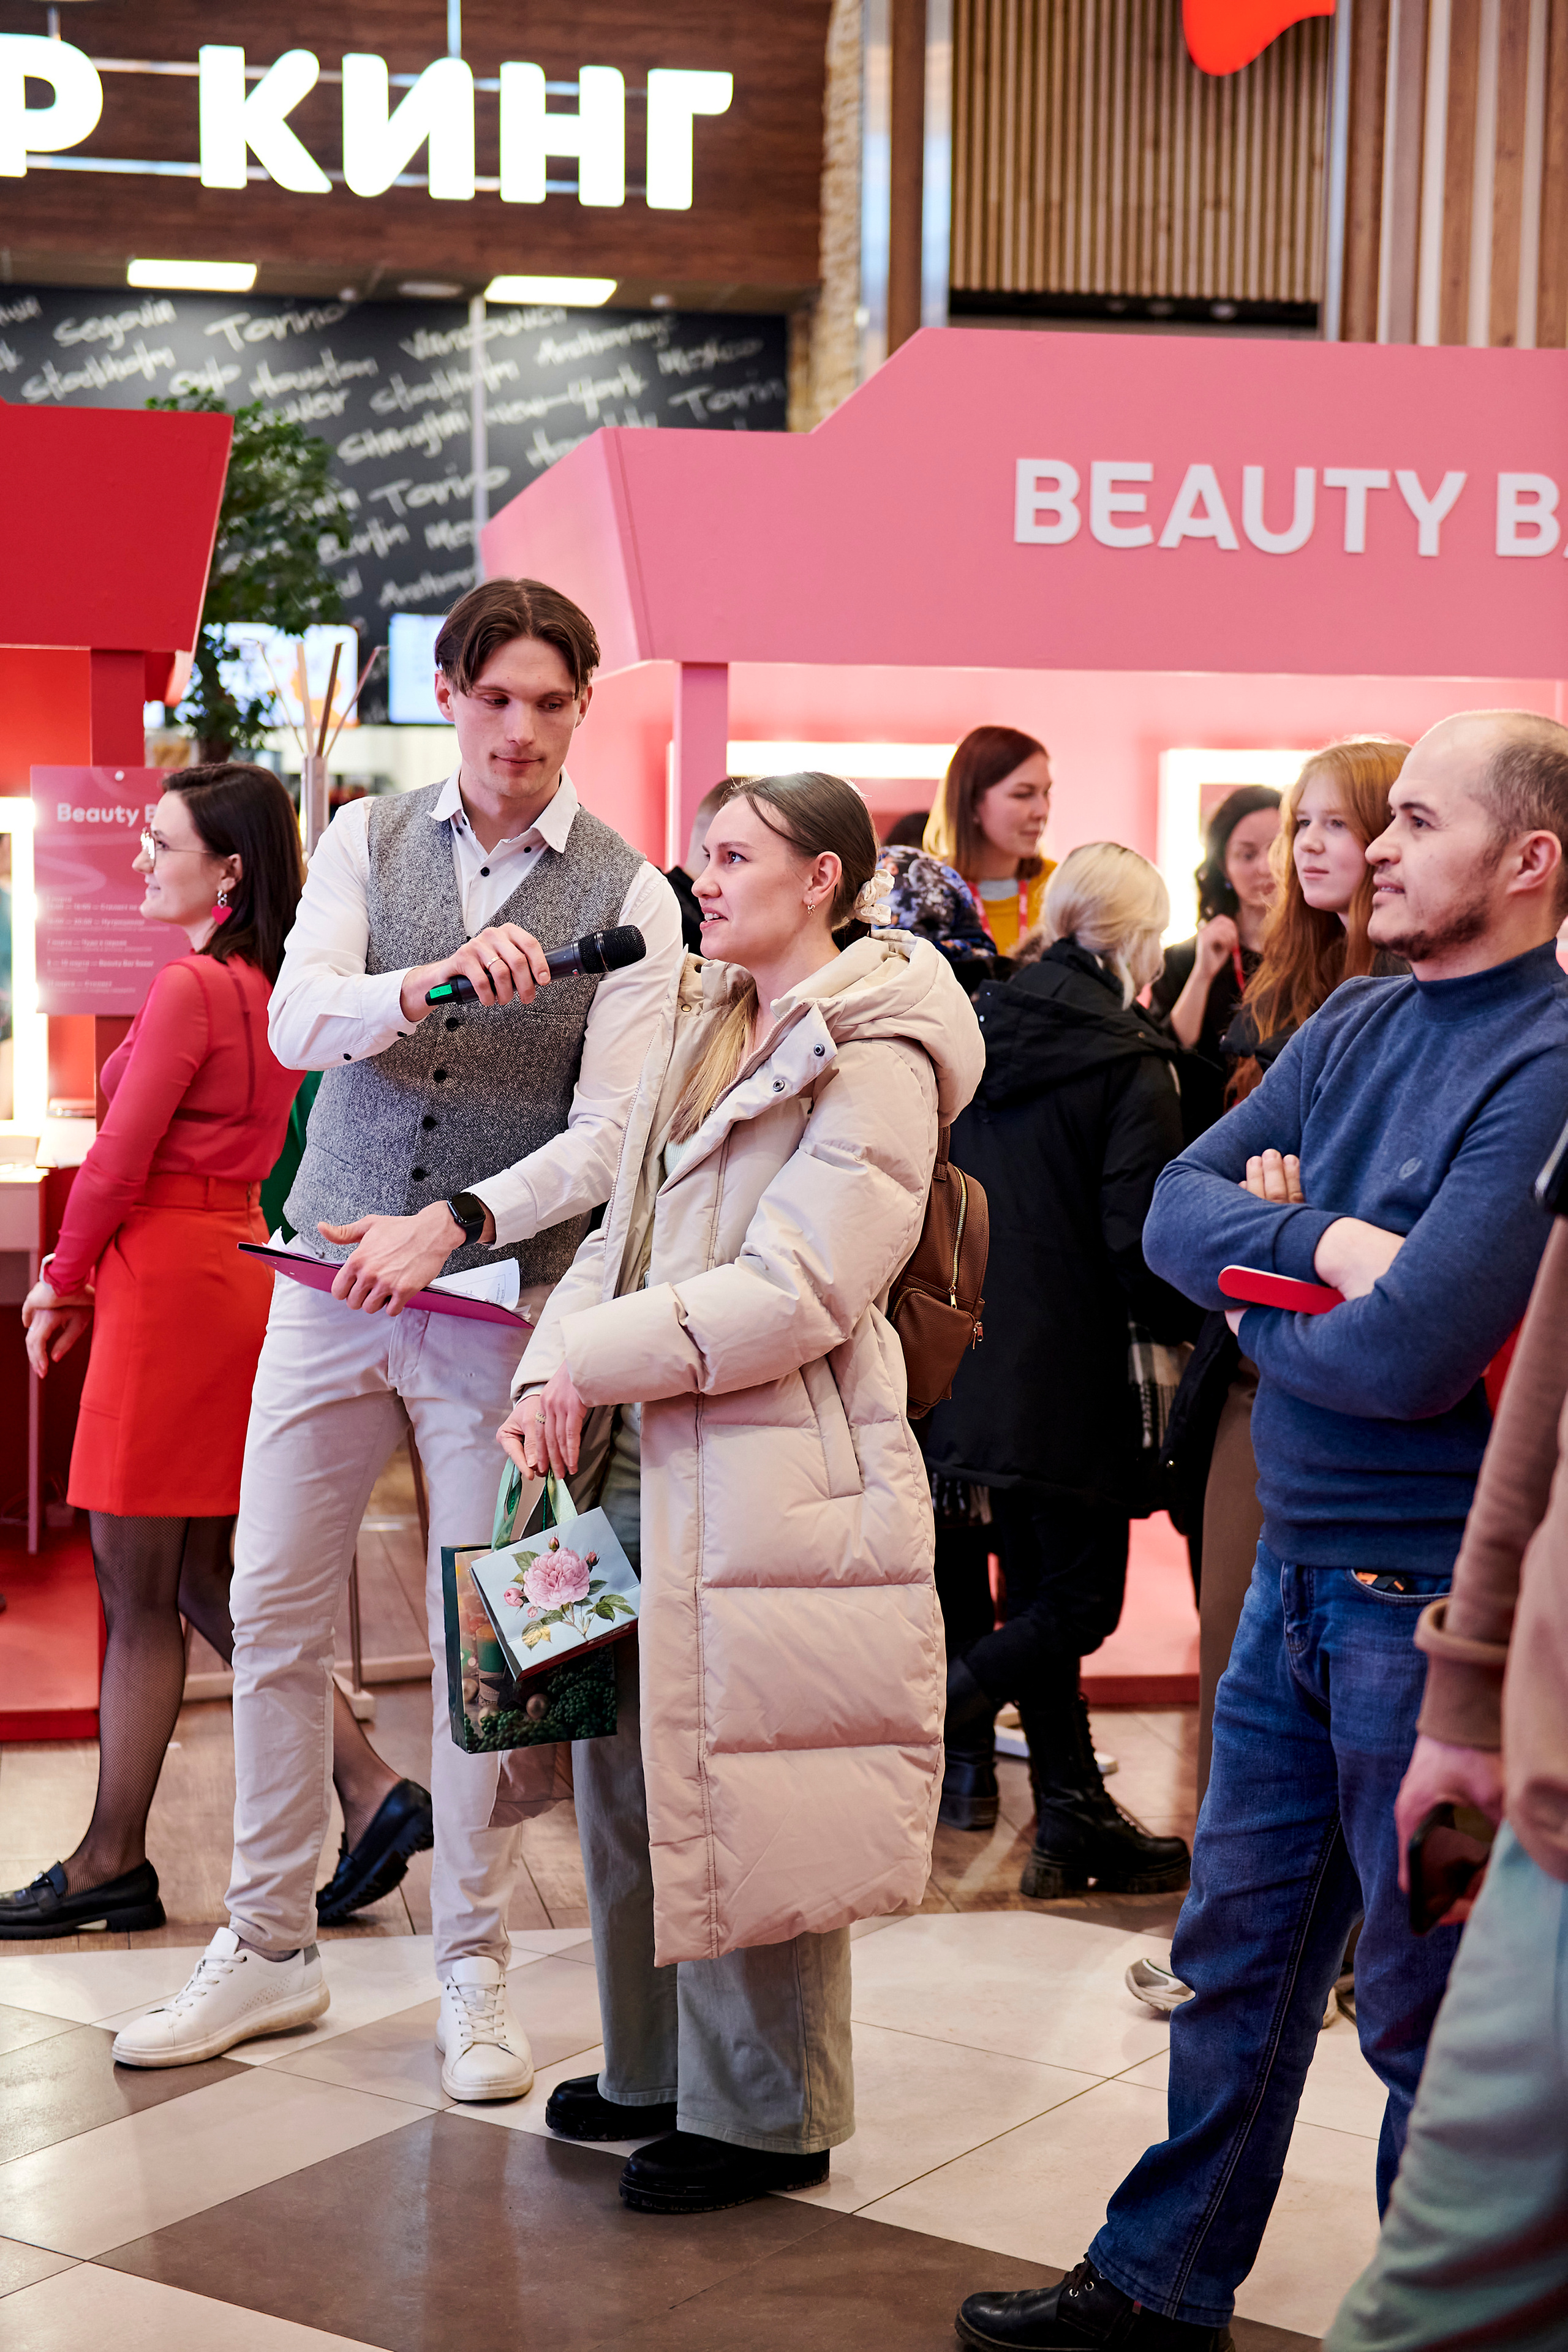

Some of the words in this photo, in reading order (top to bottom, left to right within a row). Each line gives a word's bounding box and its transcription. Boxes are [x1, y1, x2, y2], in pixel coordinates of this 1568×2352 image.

[198, 44, 734, 211] КИНГ
[1014, 458, 1468, 557] BEAUTY
[1495, 472, 1568, 558] B
[58, 802, 140, 827] Beauty
